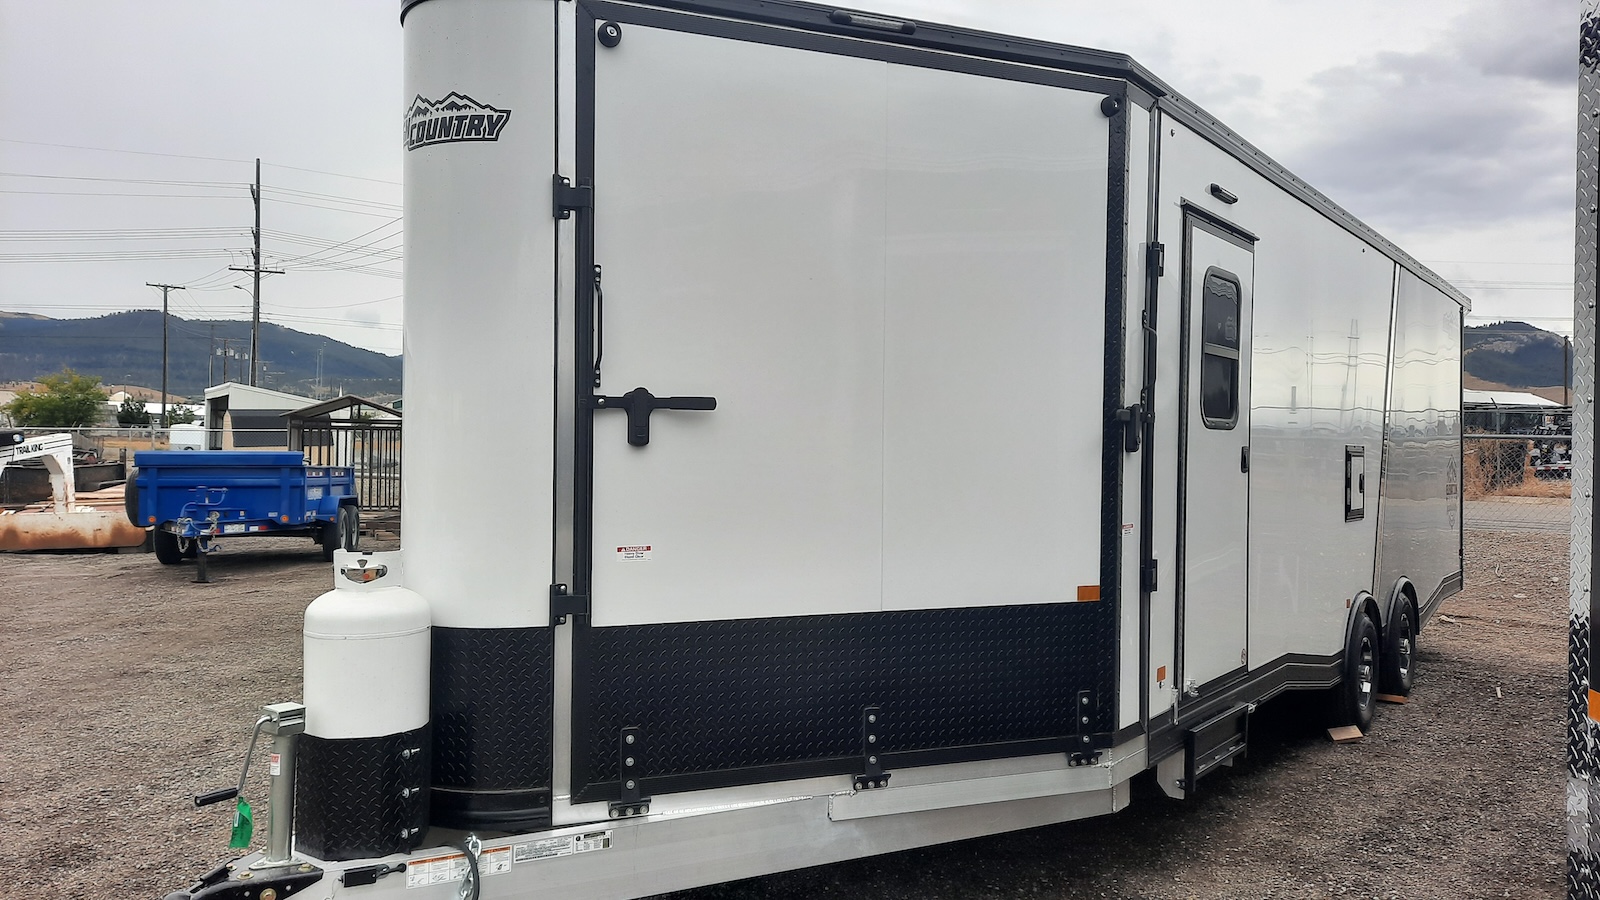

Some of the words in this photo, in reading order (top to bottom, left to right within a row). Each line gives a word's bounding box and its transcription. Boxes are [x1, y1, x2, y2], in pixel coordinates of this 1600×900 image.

[409, 114, 504, 146] COUNTRY
[16, 445, 31, 455] TRAIL
[31, 443, 44, 452] KING
